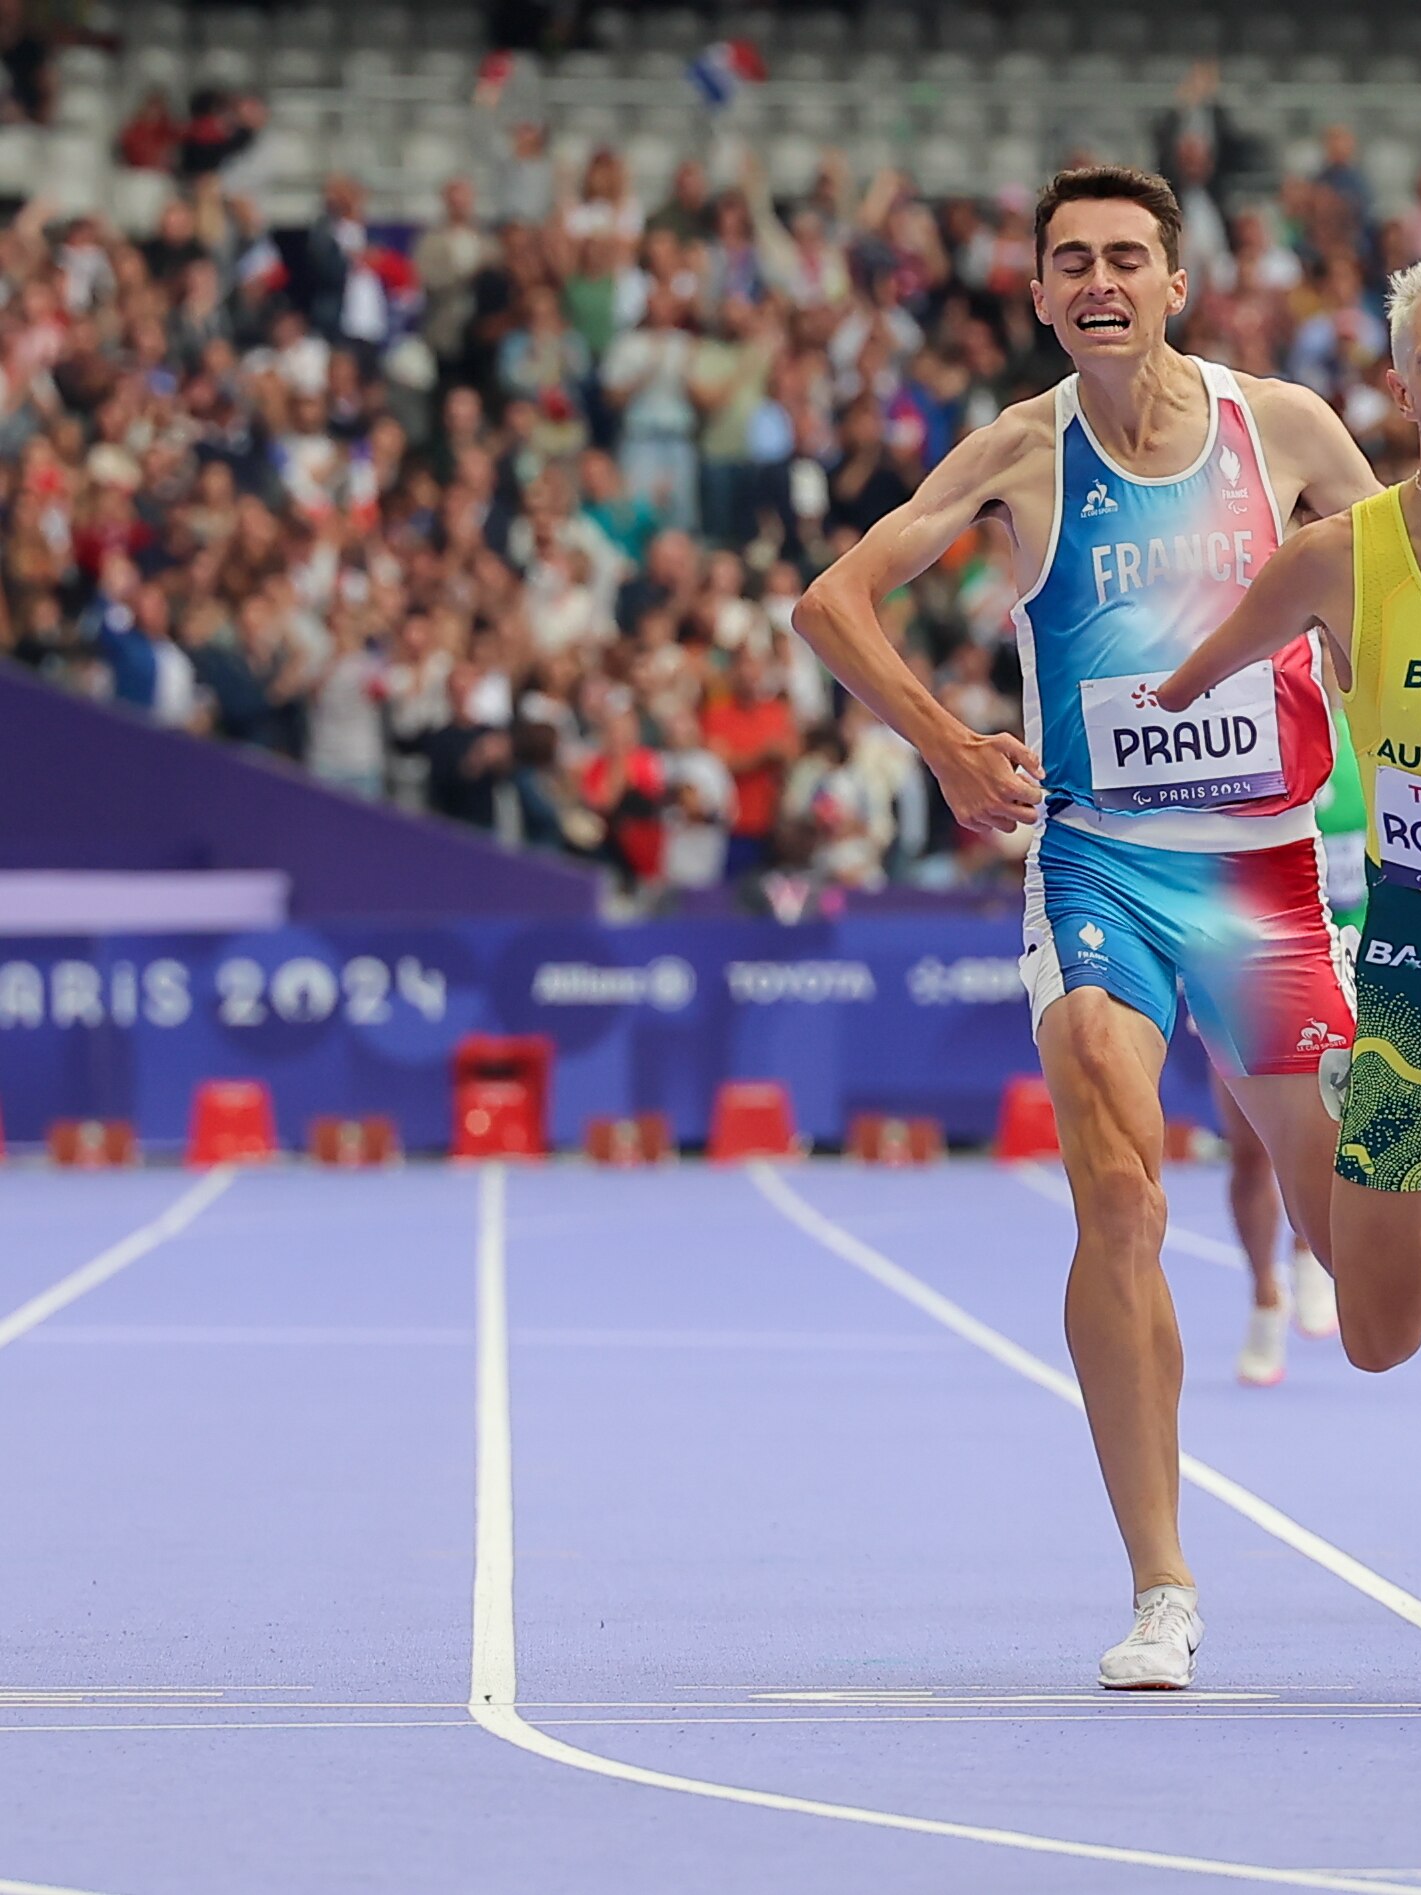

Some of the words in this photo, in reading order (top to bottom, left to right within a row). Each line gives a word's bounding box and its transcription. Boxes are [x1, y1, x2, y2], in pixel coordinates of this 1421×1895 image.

[1221, 486, 1250, 499] FRANCE
[1092, 530, 1253, 605] FRANCE
[1113, 715, 1258, 768] PRAUD
[1159, 786, 1206, 802] PARIS
[1210, 780, 1251, 797] 2024
[1364, 939, 1421, 970] BA
[213, 954, 447, 1027] 2024
